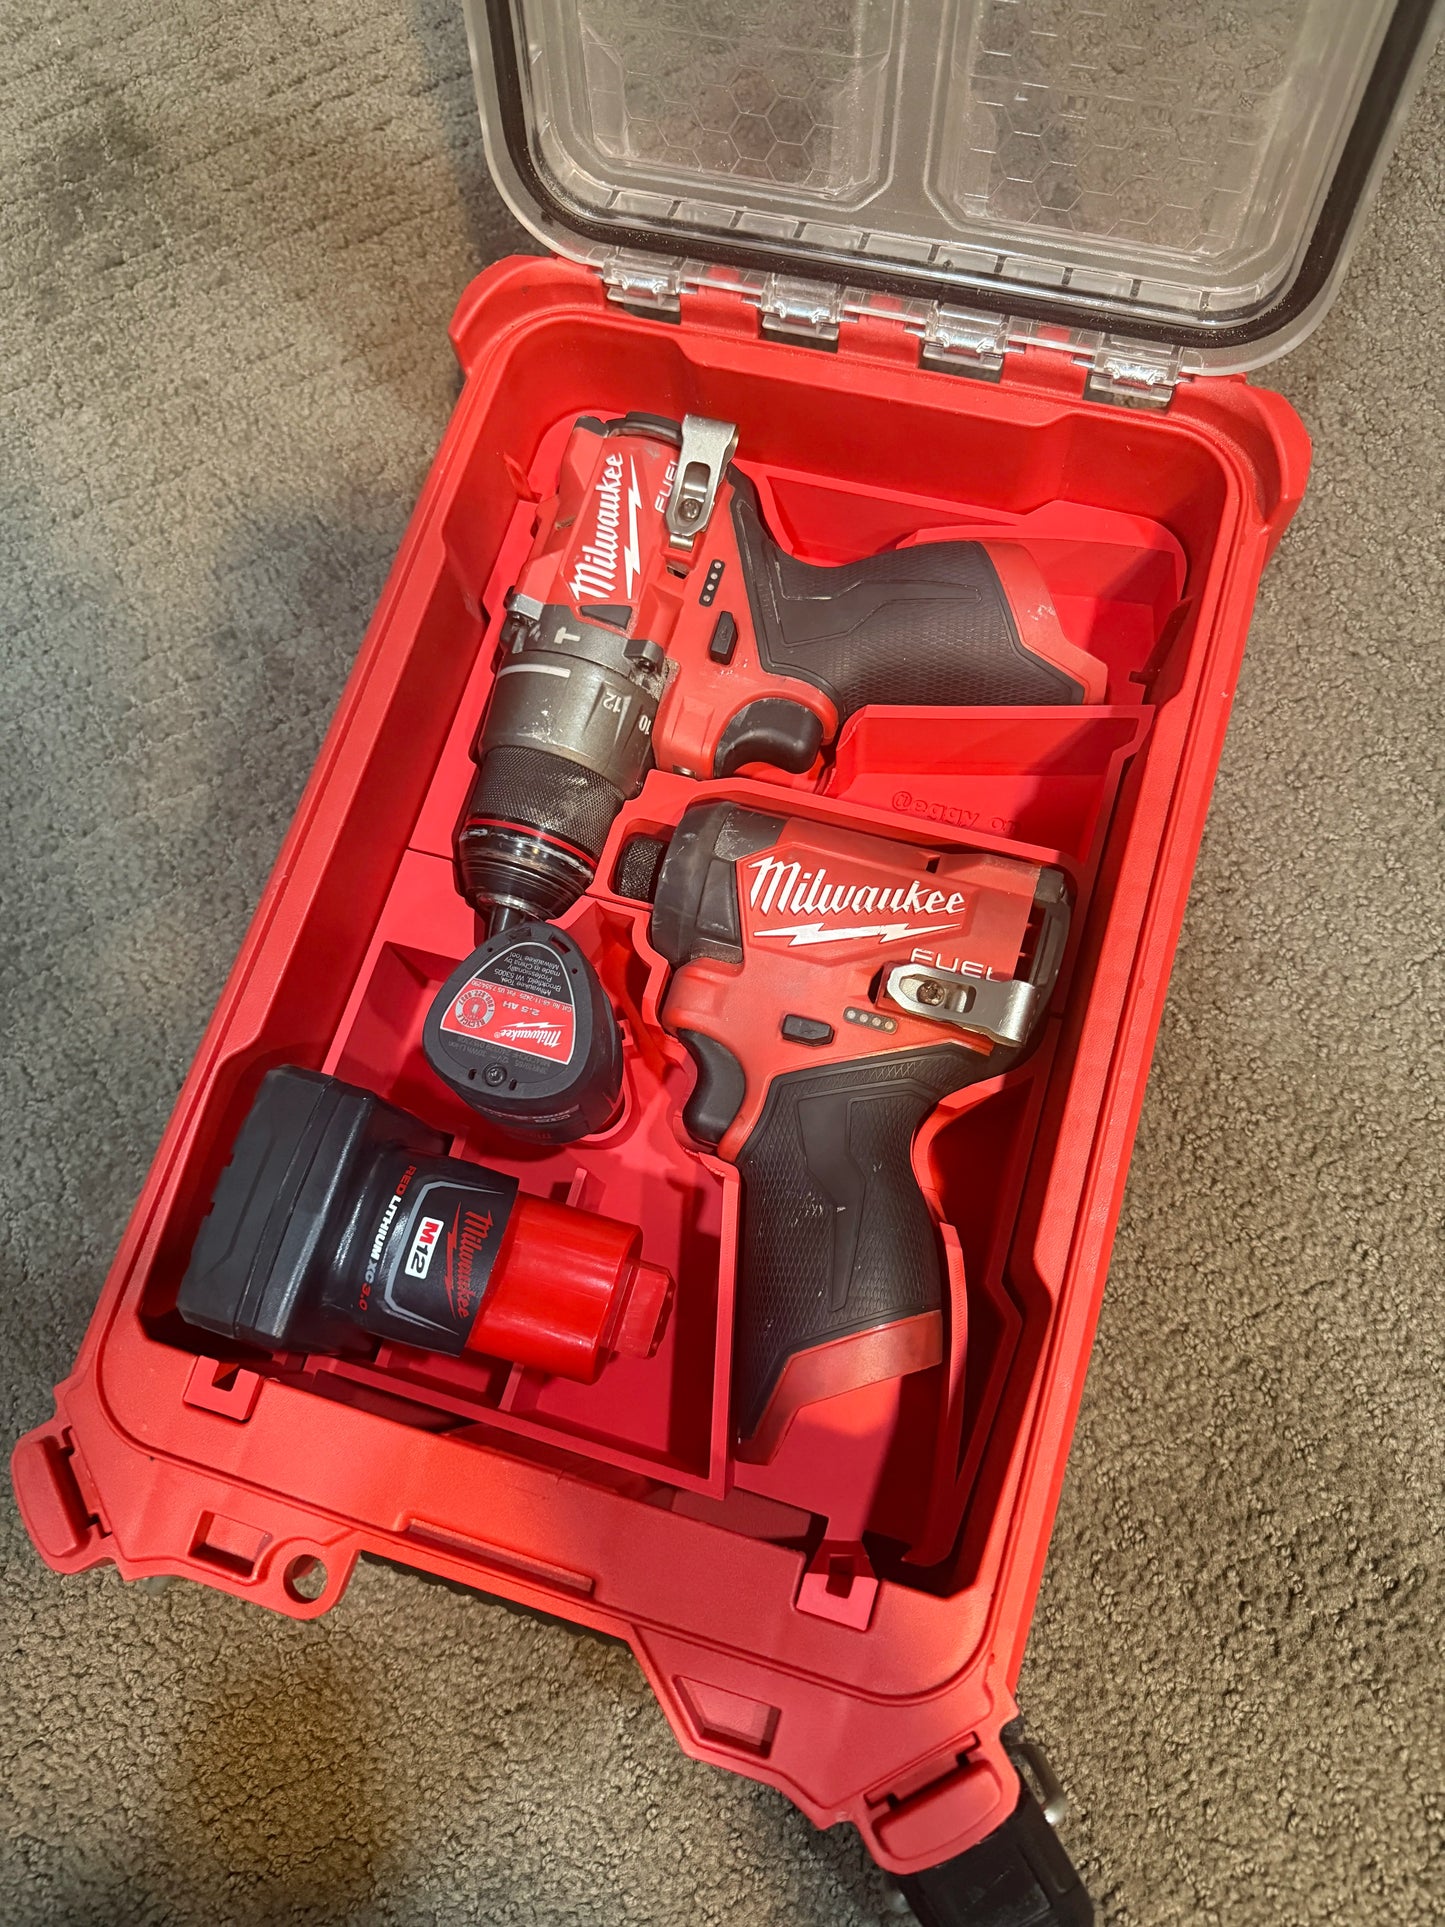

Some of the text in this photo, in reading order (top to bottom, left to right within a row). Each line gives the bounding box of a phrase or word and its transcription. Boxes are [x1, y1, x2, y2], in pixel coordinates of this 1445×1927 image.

[568, 452, 625, 600] Milwaukee
[603, 691, 622, 713] 12
[892, 790, 980, 829] @eggy
[748, 855, 967, 916] Milwaukee
[504, 956, 513, 964] by
[509, 951, 559, 970] Milwaukee Tool
[513, 960, 533, 970] China
[507, 964, 553, 982] Professionally
[541, 967, 560, 977] made
[516, 981, 551, 996] Milwaukee
[502, 1000, 540, 1016] 2.5 AH
[410, 1221, 440, 1275] M12
[457, 1209, 494, 1319] Milwaukee
[358, 1282, 371, 1311] 3.0
